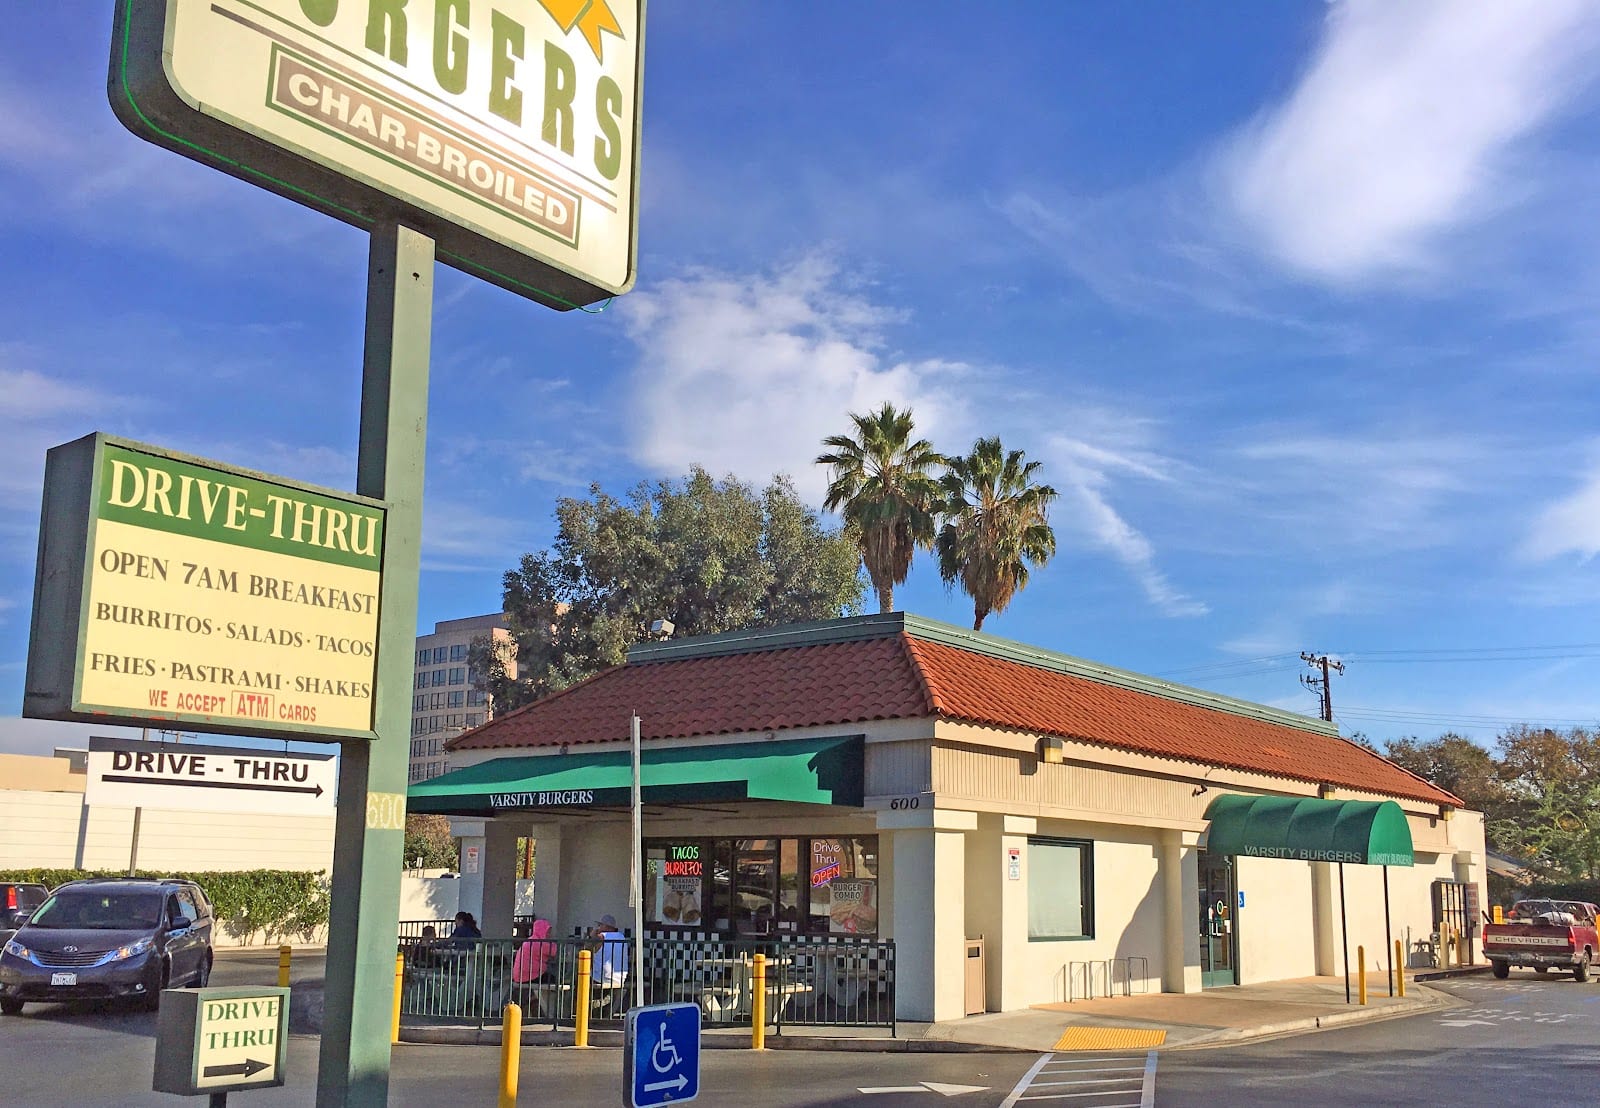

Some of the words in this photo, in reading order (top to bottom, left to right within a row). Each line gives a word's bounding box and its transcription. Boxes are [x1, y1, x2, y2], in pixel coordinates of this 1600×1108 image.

[299, 0, 623, 181] RGERS
[289, 73, 568, 226] CHAR-BROILED
[108, 459, 378, 557] DRIVE-THRU
[100, 548, 169, 582] OPEN
[182, 562, 239, 593] 7AM
[248, 574, 376, 615] BREAKFAST
[95, 602, 212, 636] BURRITOS
[226, 622, 303, 649] SALADS
[316, 634, 373, 658] TACOS
[90, 652, 156, 677] FRIES
[171, 660, 282, 691] PASTRAMI
[295, 675, 370, 699] SHAKES
[149, 689, 168, 707] WE
[177, 692, 226, 713] ACCEPT
[237, 693, 269, 718] ATM
[279, 703, 316, 722] CARDS
[112, 750, 206, 776] DRIVE
[234, 759, 309, 783] THRU
[489, 792, 536, 807] VARSITY
[538, 790, 594, 806] BURGERS
[890, 797, 919, 810] 600
[366, 792, 405, 829] 600
[671, 846, 700, 860] TACOS
[814, 842, 841, 853] Drive
[1244, 845, 1296, 858] VARSITY
[1300, 849, 1362, 863] BURGERS
[664, 861, 702, 876] BURRITOS
[815, 853, 836, 864] Thru
[812, 865, 840, 885] OPEN
[833, 883, 862, 892] BURGER
[834, 892, 861, 900] COMBO
[1495, 936, 1560, 944] CHEVROLET
[207, 1001, 278, 1021] DRIVE
[206, 1029, 274, 1049] THRU
